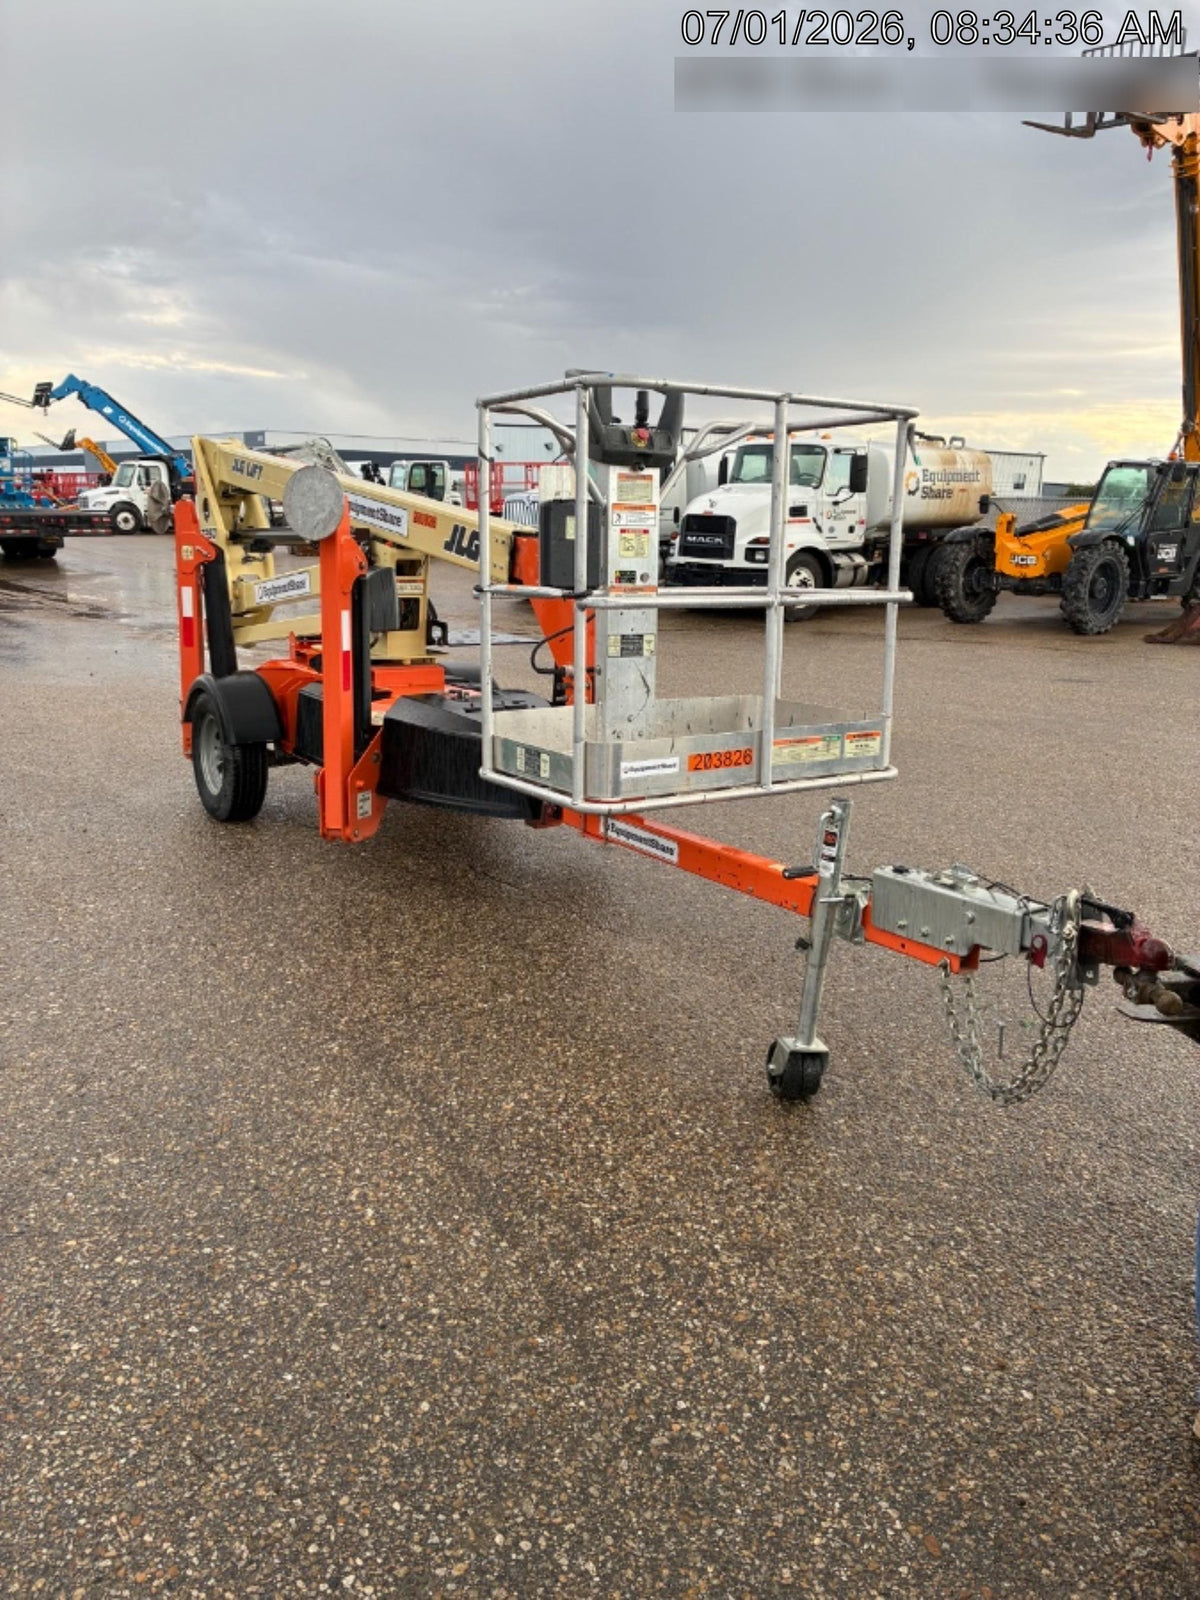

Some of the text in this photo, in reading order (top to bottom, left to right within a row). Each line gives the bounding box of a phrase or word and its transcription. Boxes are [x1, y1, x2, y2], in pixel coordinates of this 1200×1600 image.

[922, 468, 981, 486] Equipment
[921, 486, 953, 499] Share
[349, 501, 402, 528] uipmentShare
[443, 523, 480, 562] JLG
[686, 535, 725, 545] MACK
[1009, 554, 1037, 565] JCB
[693, 748, 753, 771] 203826
